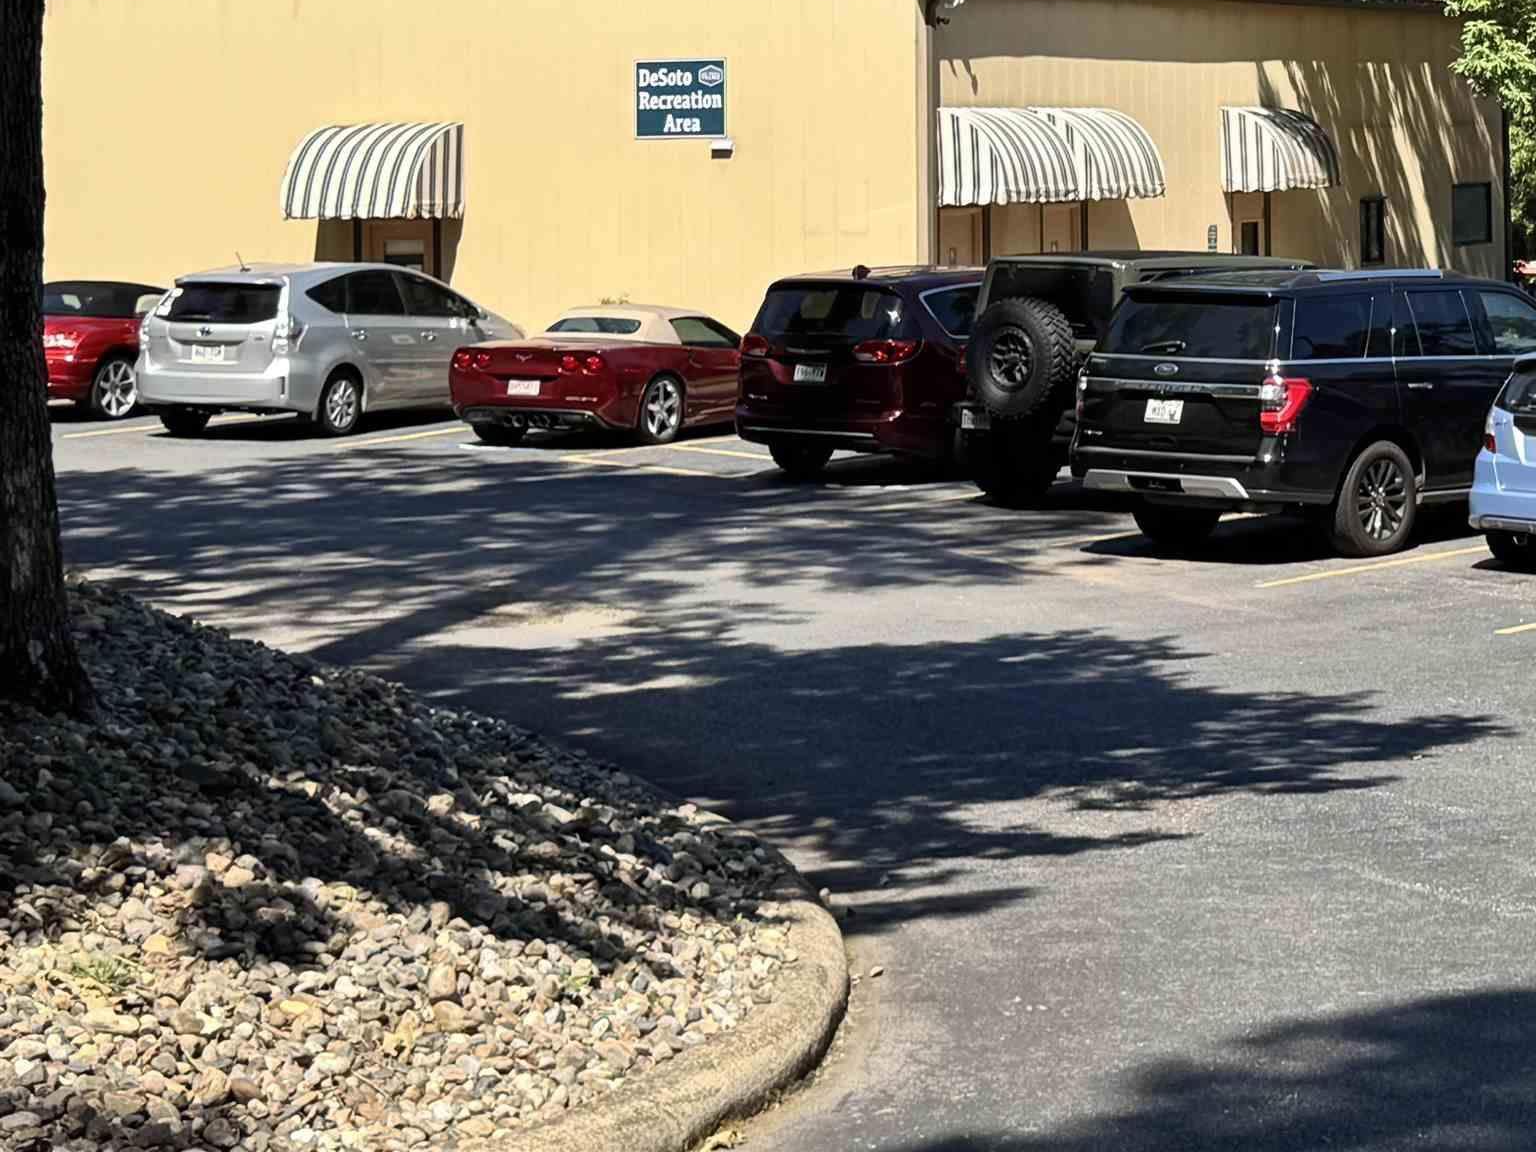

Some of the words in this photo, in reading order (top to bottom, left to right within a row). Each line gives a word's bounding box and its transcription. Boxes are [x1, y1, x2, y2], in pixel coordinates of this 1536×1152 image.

[638, 68, 693, 88] DeSoto
[638, 90, 722, 111] Recreation
[663, 113, 702, 134] Area
